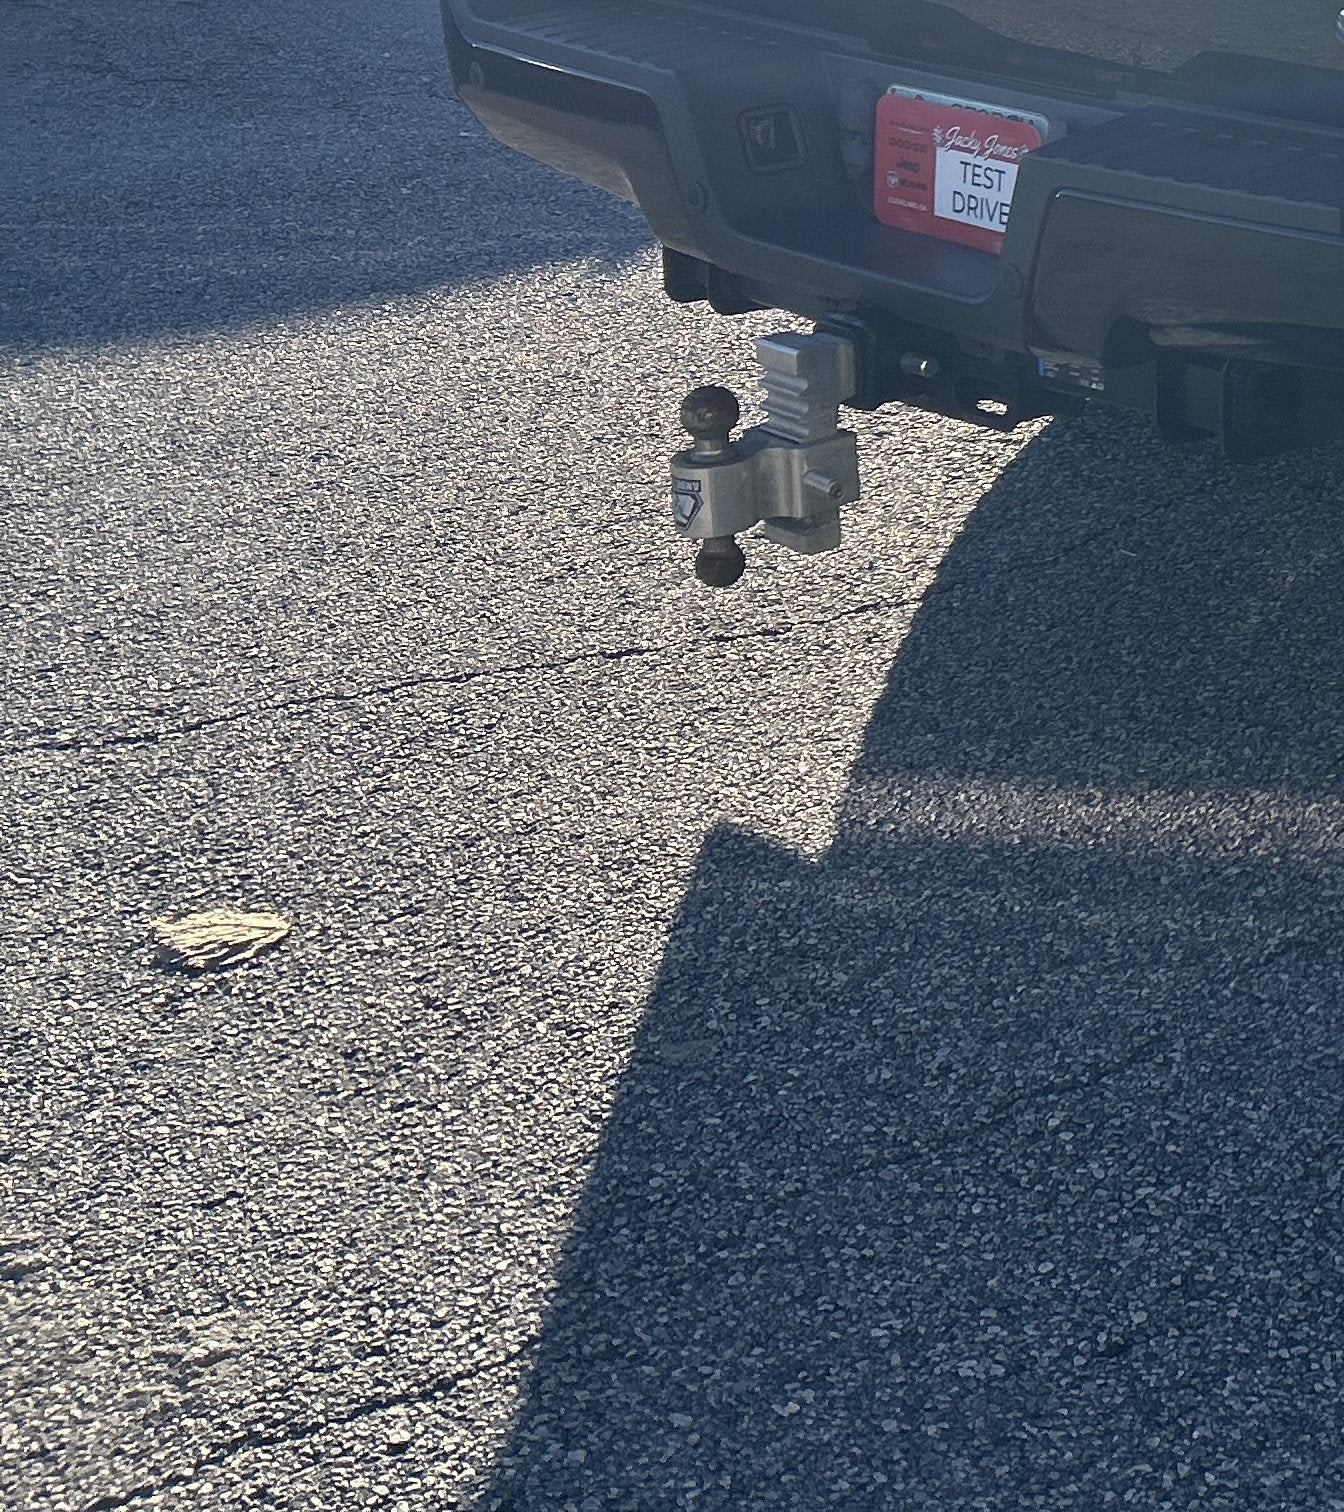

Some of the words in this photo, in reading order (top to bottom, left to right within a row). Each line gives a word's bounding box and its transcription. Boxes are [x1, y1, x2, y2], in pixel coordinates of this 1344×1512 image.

[944, 126, 981, 158] Jacky
[960, 160, 1006, 192] TEST
[952, 191, 1011, 225] DRIVE
